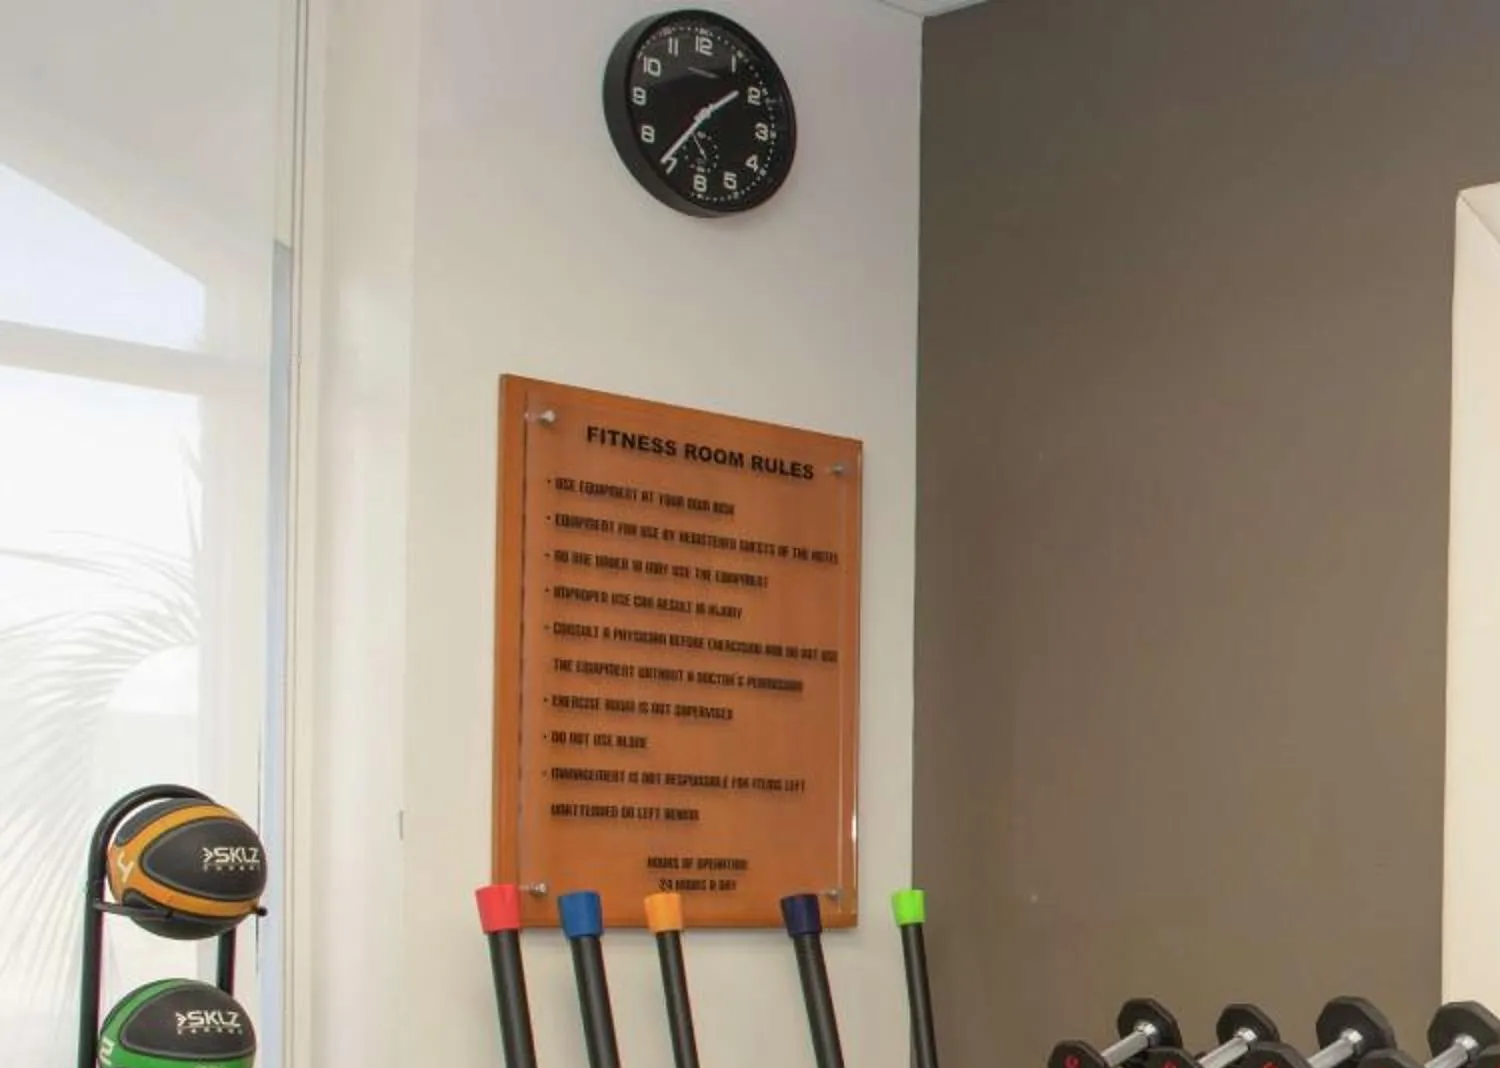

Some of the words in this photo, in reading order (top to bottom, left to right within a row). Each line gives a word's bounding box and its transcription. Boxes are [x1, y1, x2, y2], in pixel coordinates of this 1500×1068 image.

[755, 122, 769, 141] 3
[585, 426, 677, 457] FITNESS
[683, 443, 744, 469] ROOM
[750, 454, 814, 480] RULES
[213, 847, 261, 863] SKLZ
[187, 1009, 241, 1028] SKLZ
